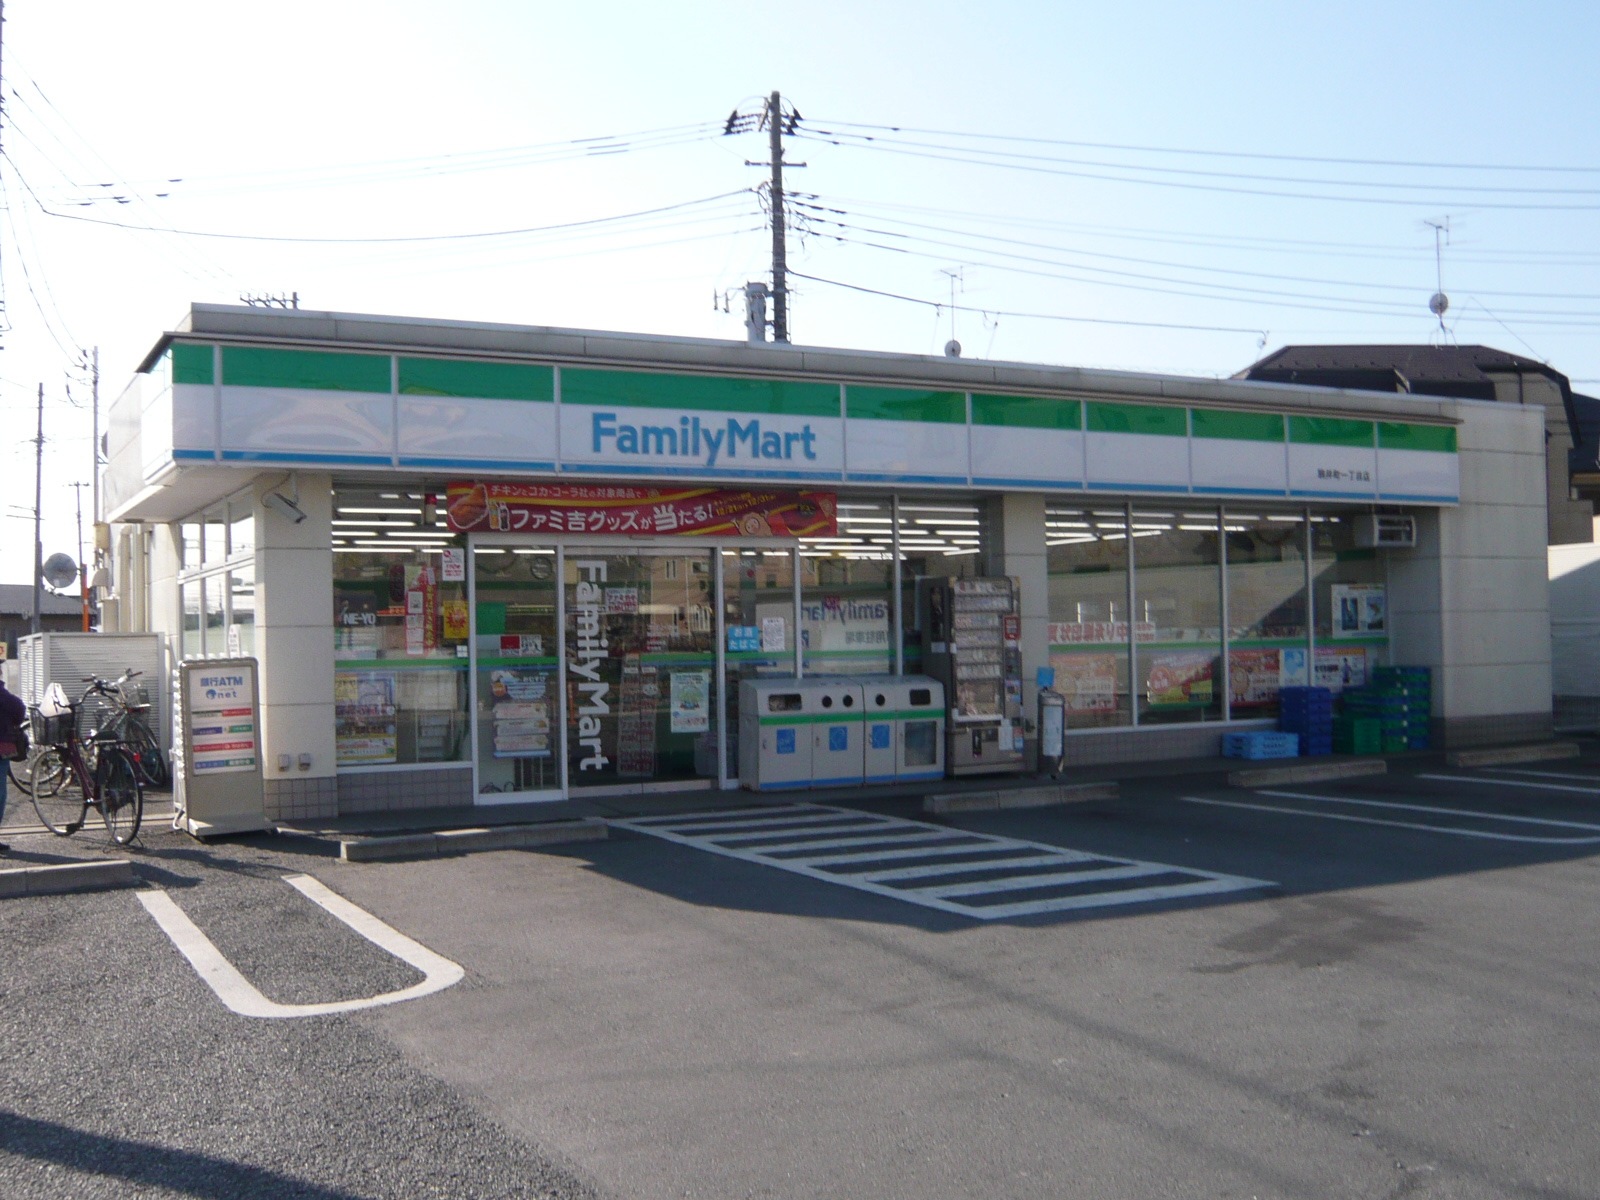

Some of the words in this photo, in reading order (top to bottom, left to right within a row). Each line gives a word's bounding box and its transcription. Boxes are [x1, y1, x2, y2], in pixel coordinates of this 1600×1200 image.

[592, 412, 816, 467] FamilyMart
[343, 612, 376, 626] NE-YO
[729, 639, 759, 650] たばこ
[569, 560, 610, 771] FamilyMart
